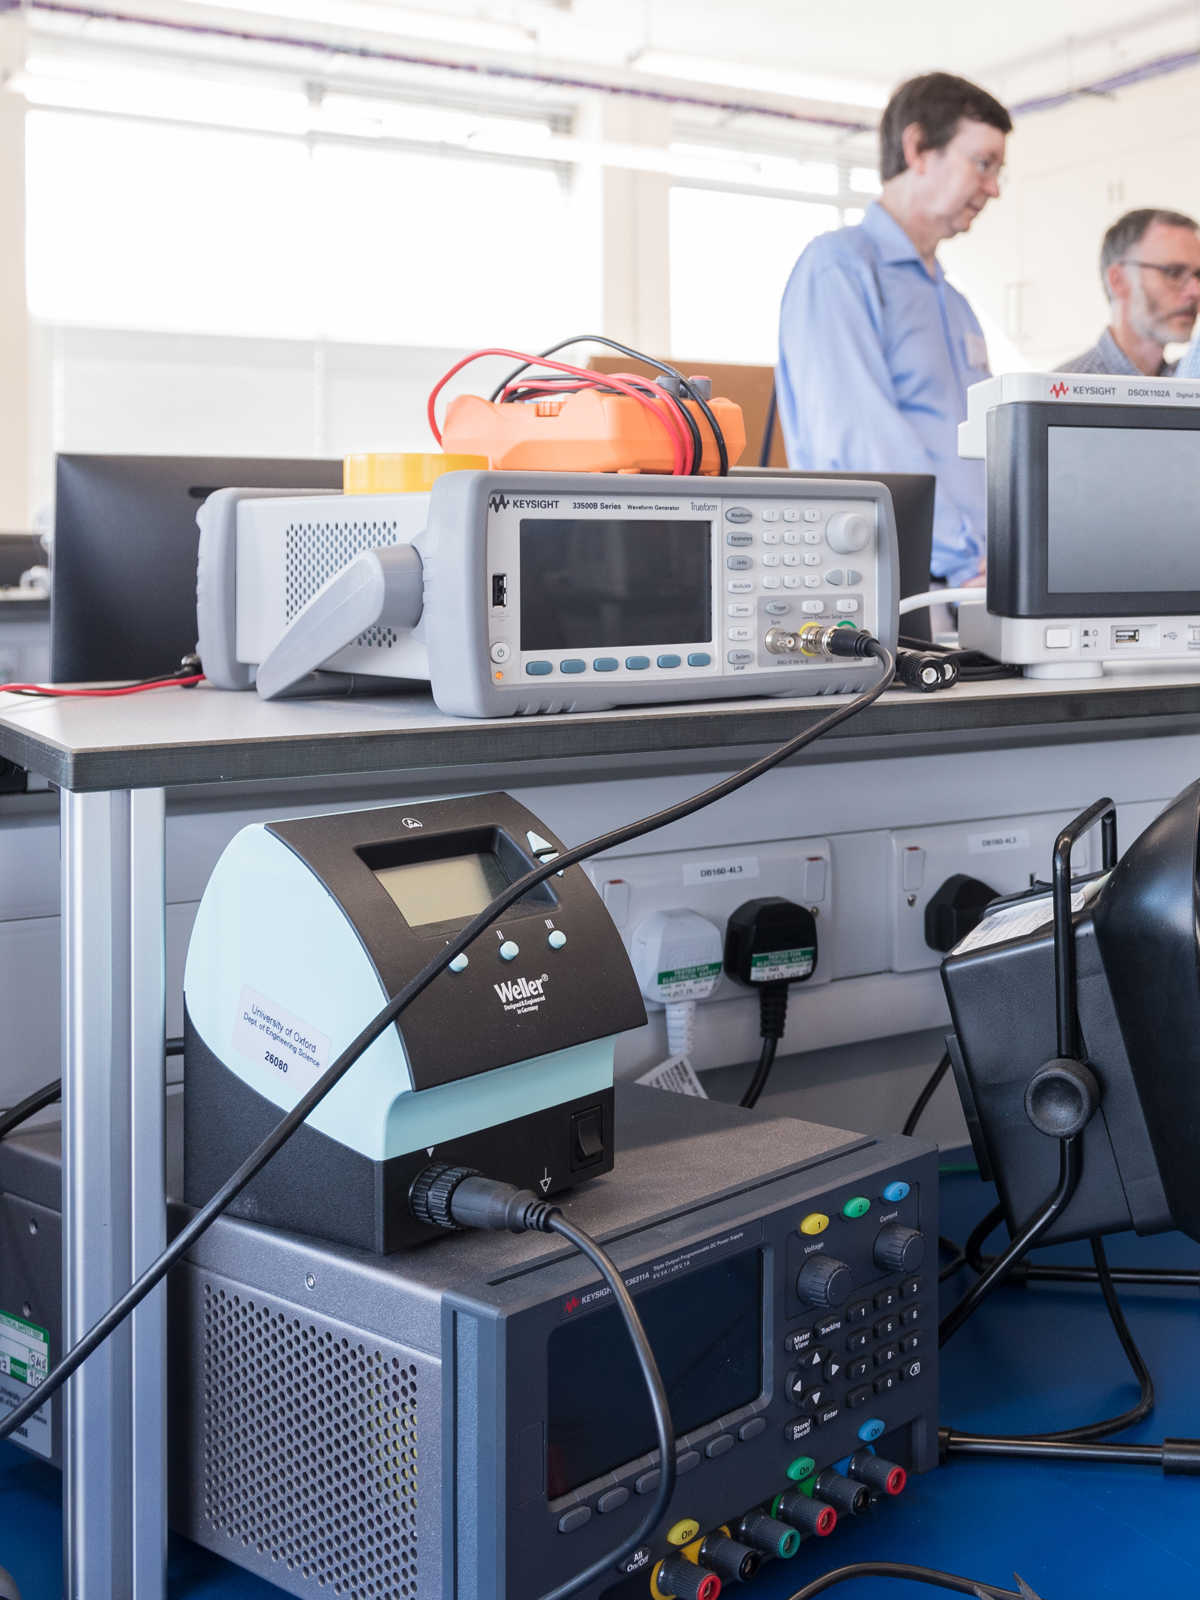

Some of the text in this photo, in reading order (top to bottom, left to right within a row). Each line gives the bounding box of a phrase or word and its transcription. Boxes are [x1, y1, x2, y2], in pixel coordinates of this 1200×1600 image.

[1072, 385, 1116, 396] KEYSIGHT
[1127, 388, 1170, 398] DSOX1102A
[512, 499, 560, 510] KEYSIGHT
[572, 502, 598, 510] 33500B
[599, 502, 622, 511] Series
[251, 1003, 317, 1053] University of Oxford
[243, 1011, 320, 1068] Dept. of Engineering Science
[264, 1050, 289, 1073] 26080
[817, 1221, 821, 1230] 1
[803, 1241, 825, 1255] Voltage
[912, 1283, 918, 1292] 3
[581, 1286, 612, 1305] KEYSIGH
[887, 1295, 893, 1304] 2
[860, 1307, 865, 1317] 1
[912, 1310, 918, 1319] 6
[820, 1321, 841, 1335] Tracking
[887, 1323, 893, 1331] 5
[793, 1331, 811, 1344] Meter
[860, 1335, 866, 1344] 4
[912, 1337, 918, 1347] 9
[794, 1340, 810, 1350] View
[860, 1364, 866, 1373] 7
[887, 1379, 892, 1387] 0
[823, 1409, 838, 1422] Enter
[793, 1418, 811, 1434] Store/
[870, 1426, 882, 1437] On
[793, 1427, 811, 1441] Recall
[799, 1464, 810, 1477] On
[681, 1526, 694, 1541] On
[633, 1550, 643, 1562] All
[626, 1555, 649, 1572] On/Off
